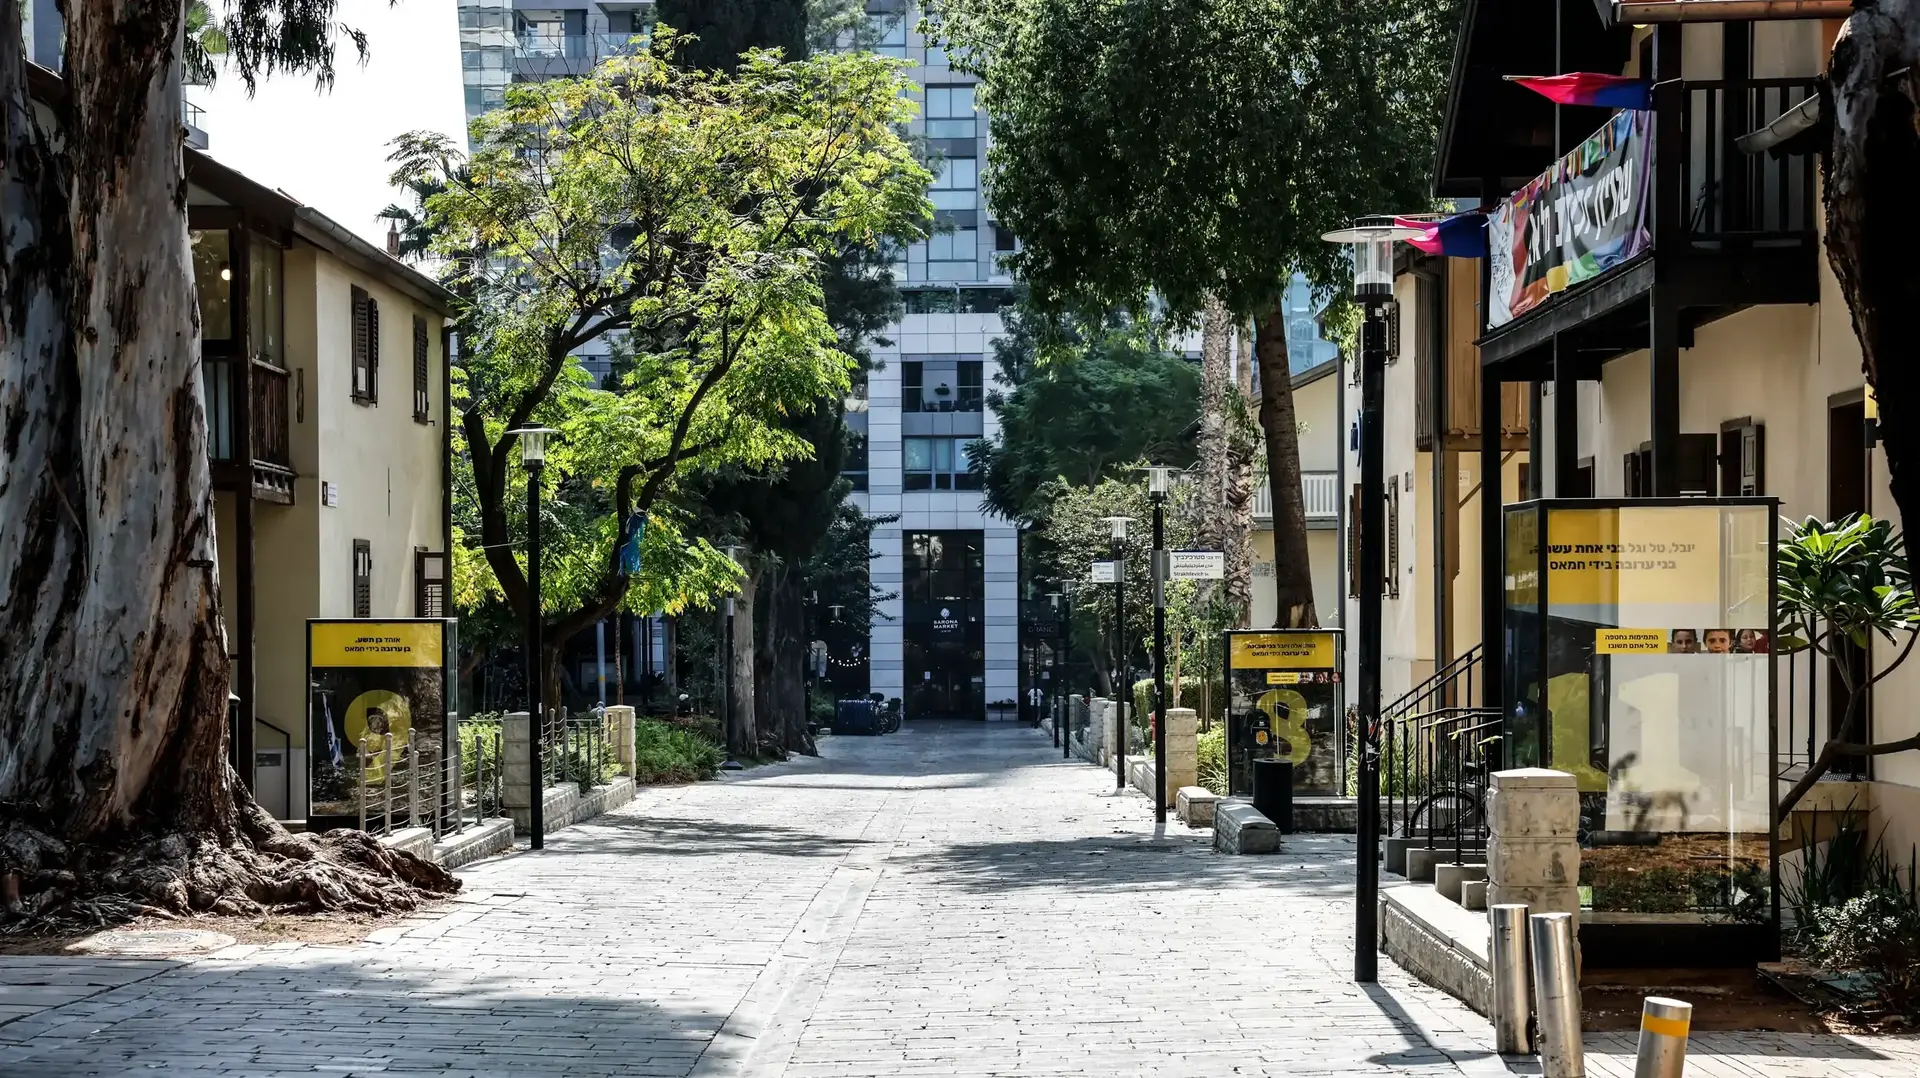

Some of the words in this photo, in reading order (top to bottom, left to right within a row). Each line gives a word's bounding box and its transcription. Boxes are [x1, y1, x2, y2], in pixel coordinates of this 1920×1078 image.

[1574, 543, 1604, 553] אחת
[1606, 543, 1627, 553] בני
[1628, 541, 1646, 553] וגל
[1649, 541, 1666, 553] טל
[1669, 541, 1695, 554] יובל,
[1550, 560, 1586, 569] חמאס
[1589, 560, 1612, 569] בידי
[1615, 560, 1654, 569] ערובה
[1657, 560, 1677, 569] בני
[375, 636, 383, 644] בן
[344, 645, 365, 653] חמאס
[365, 645, 380, 653] בידי
[380, 645, 403, 653] ערובה
[403, 645, 412, 653] בן
[1256, 688, 1312, 768] 8
[344, 690, 412, 786] 9
